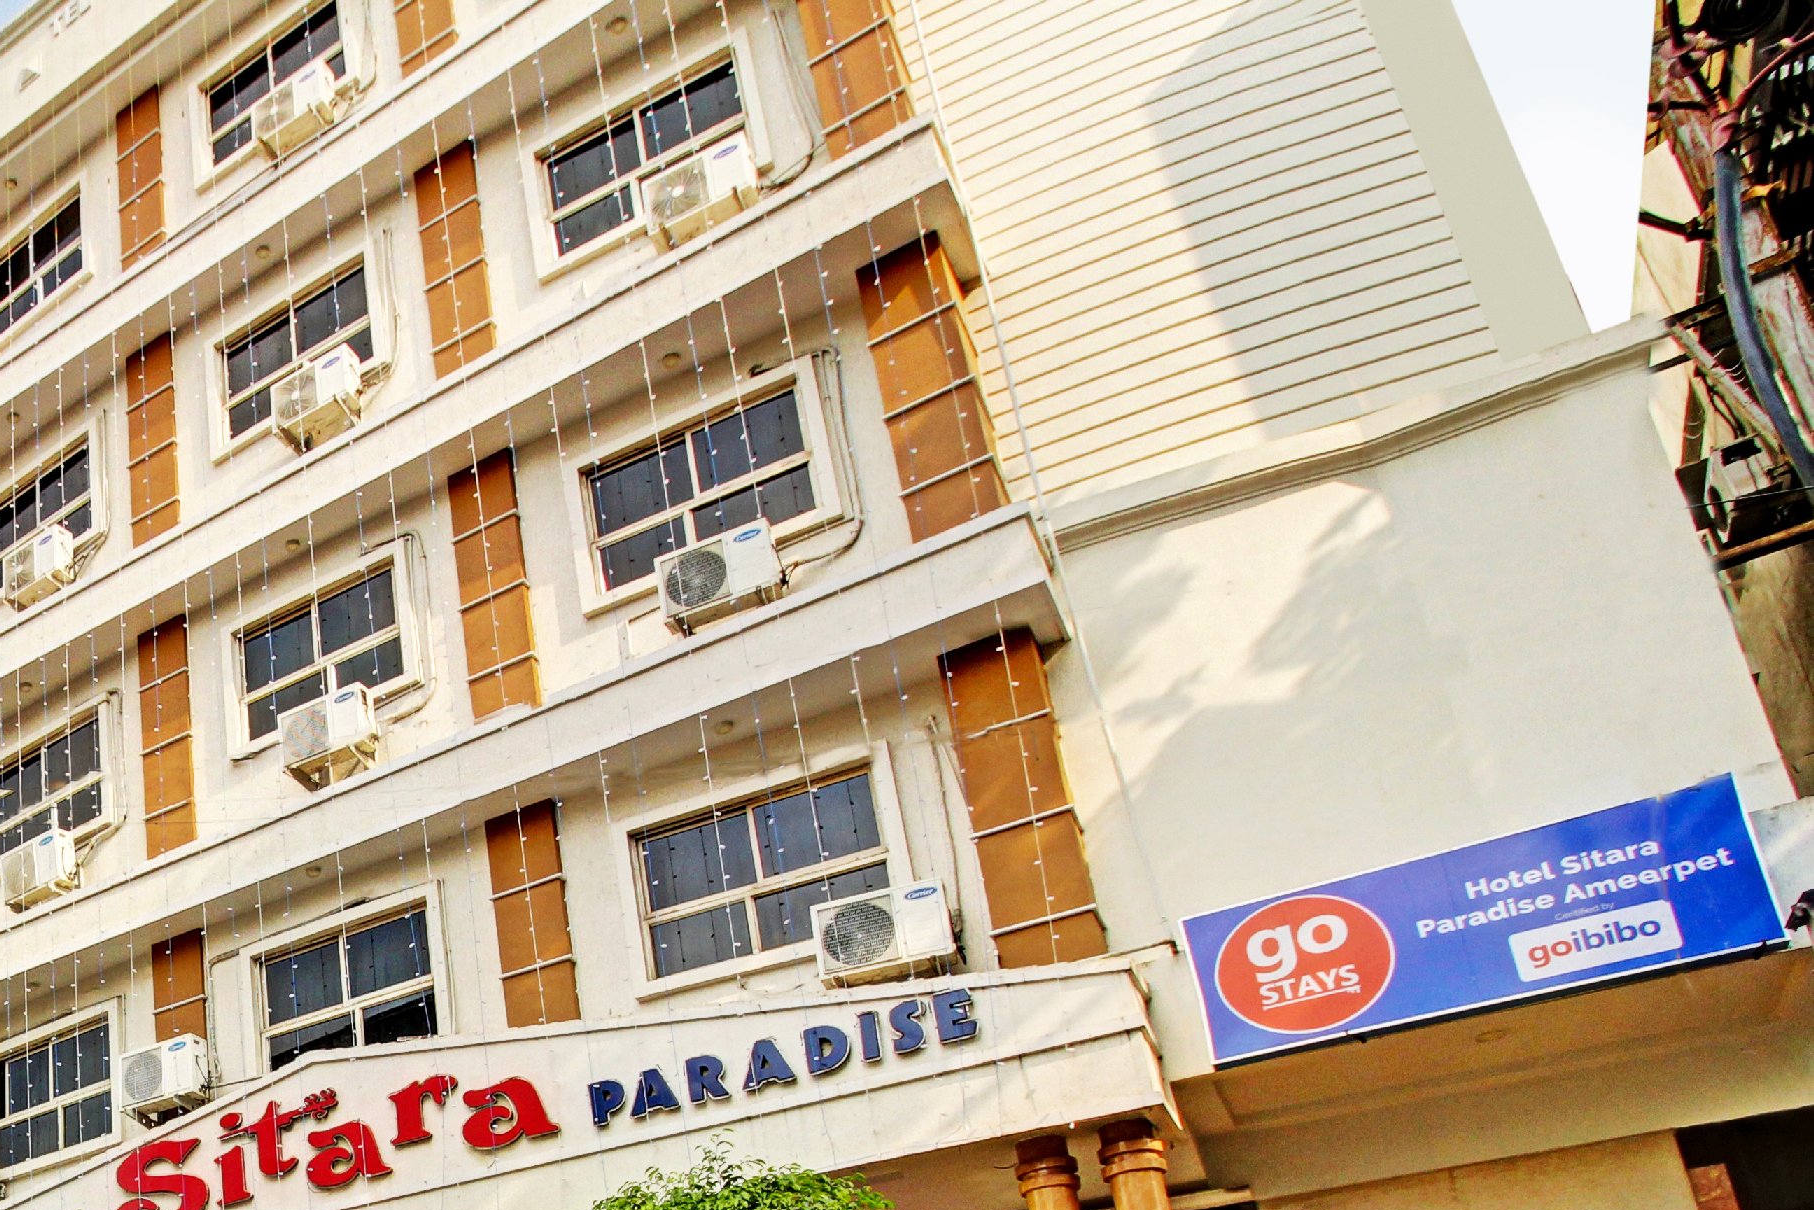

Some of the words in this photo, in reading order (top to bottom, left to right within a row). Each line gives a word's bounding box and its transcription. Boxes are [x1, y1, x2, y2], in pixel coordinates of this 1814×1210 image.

[905, 887, 937, 900] Carrier
[1415, 893, 1555, 939] Paradise
[1563, 847, 1735, 904] Ameerpet
[1464, 861, 1557, 901] Hotel
[1559, 839, 1661, 876] Sitara
[1601, 902, 1614, 912] by
[1246, 914, 1349, 983] go
[1527, 918, 1662, 970] goibibo
[1259, 963, 1360, 1005] STAYS
[587, 987, 980, 1128] PARADISE
